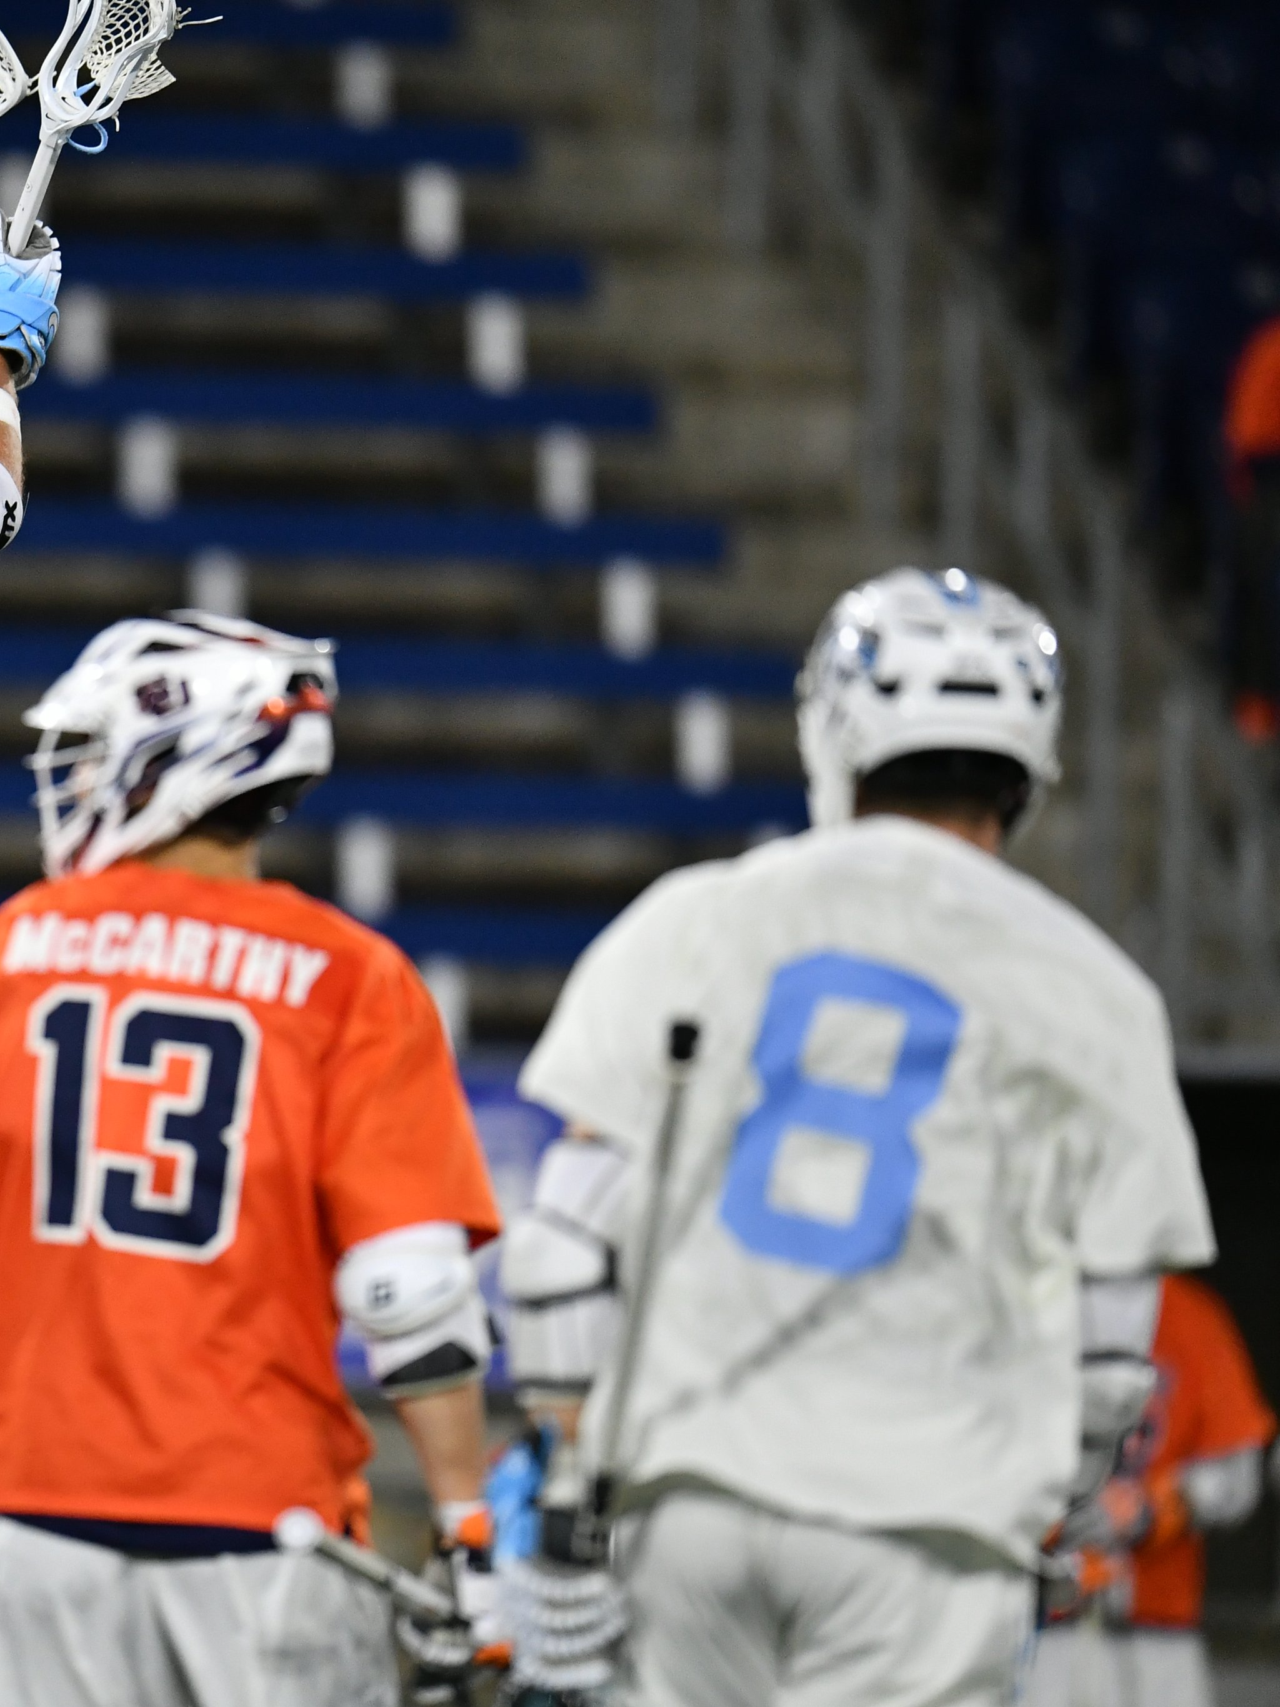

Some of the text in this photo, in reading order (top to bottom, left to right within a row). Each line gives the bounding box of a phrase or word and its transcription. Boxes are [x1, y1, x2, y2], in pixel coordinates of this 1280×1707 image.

[1, 910, 330, 1008] McCARTHY
[26, 982, 261, 1263] 13
[721, 948, 964, 1278] 8
